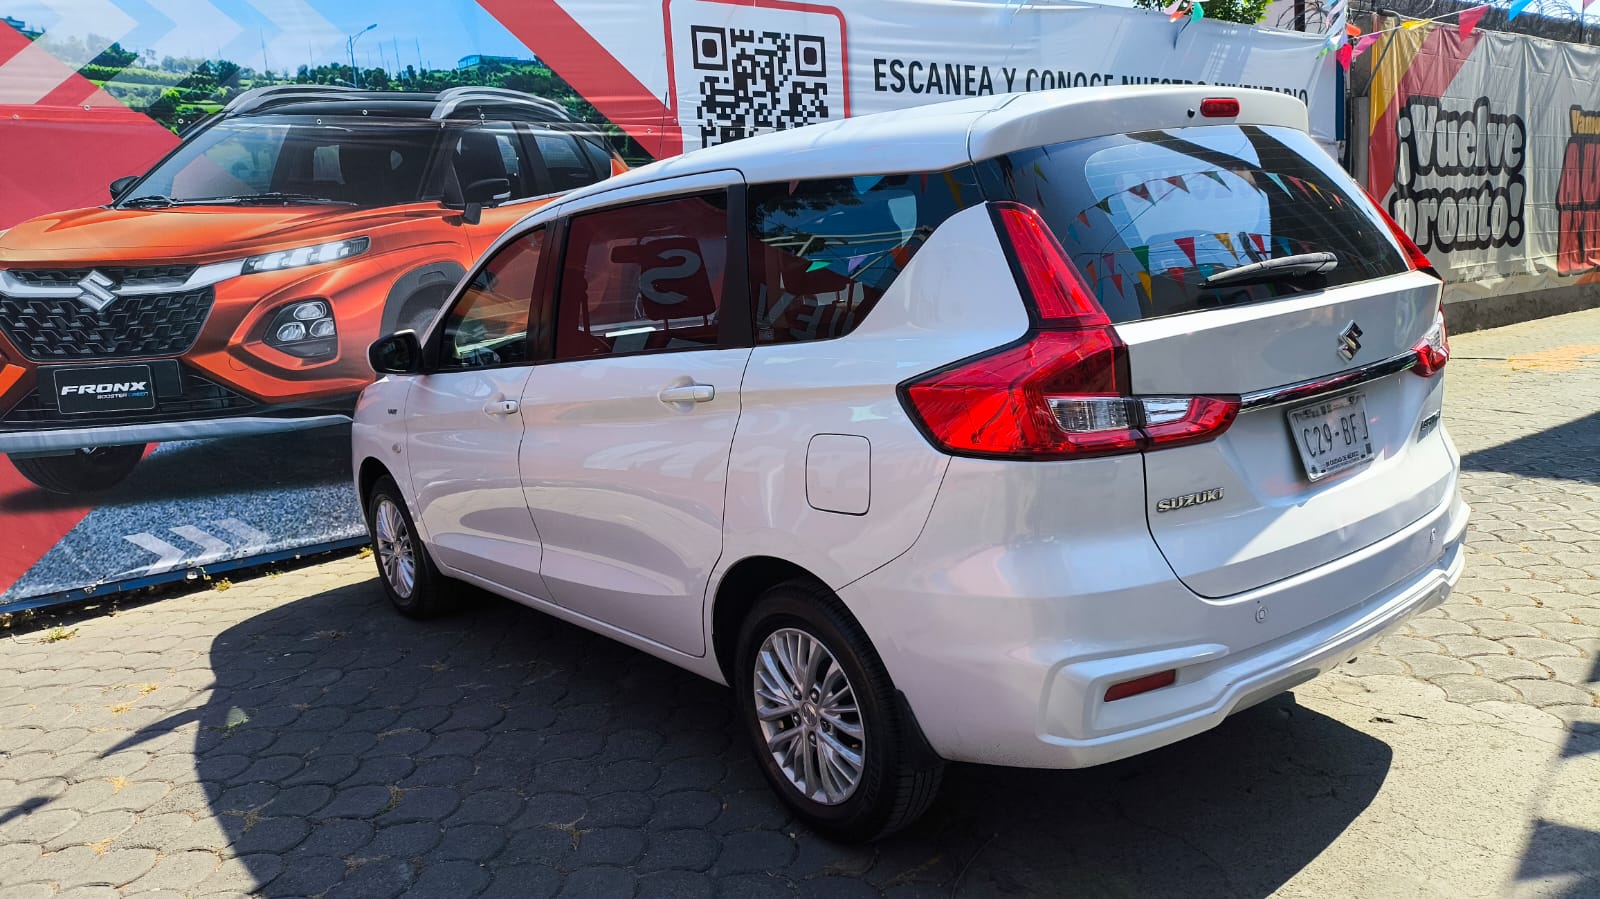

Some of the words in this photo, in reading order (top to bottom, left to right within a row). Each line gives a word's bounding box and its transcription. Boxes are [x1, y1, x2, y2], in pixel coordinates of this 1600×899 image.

[873, 58, 994, 96] ESCANEA
[1002, 67, 1017, 93] Y
[61, 381, 148, 396] FRONX
[1156, 487, 1224, 513] SUZUKI
